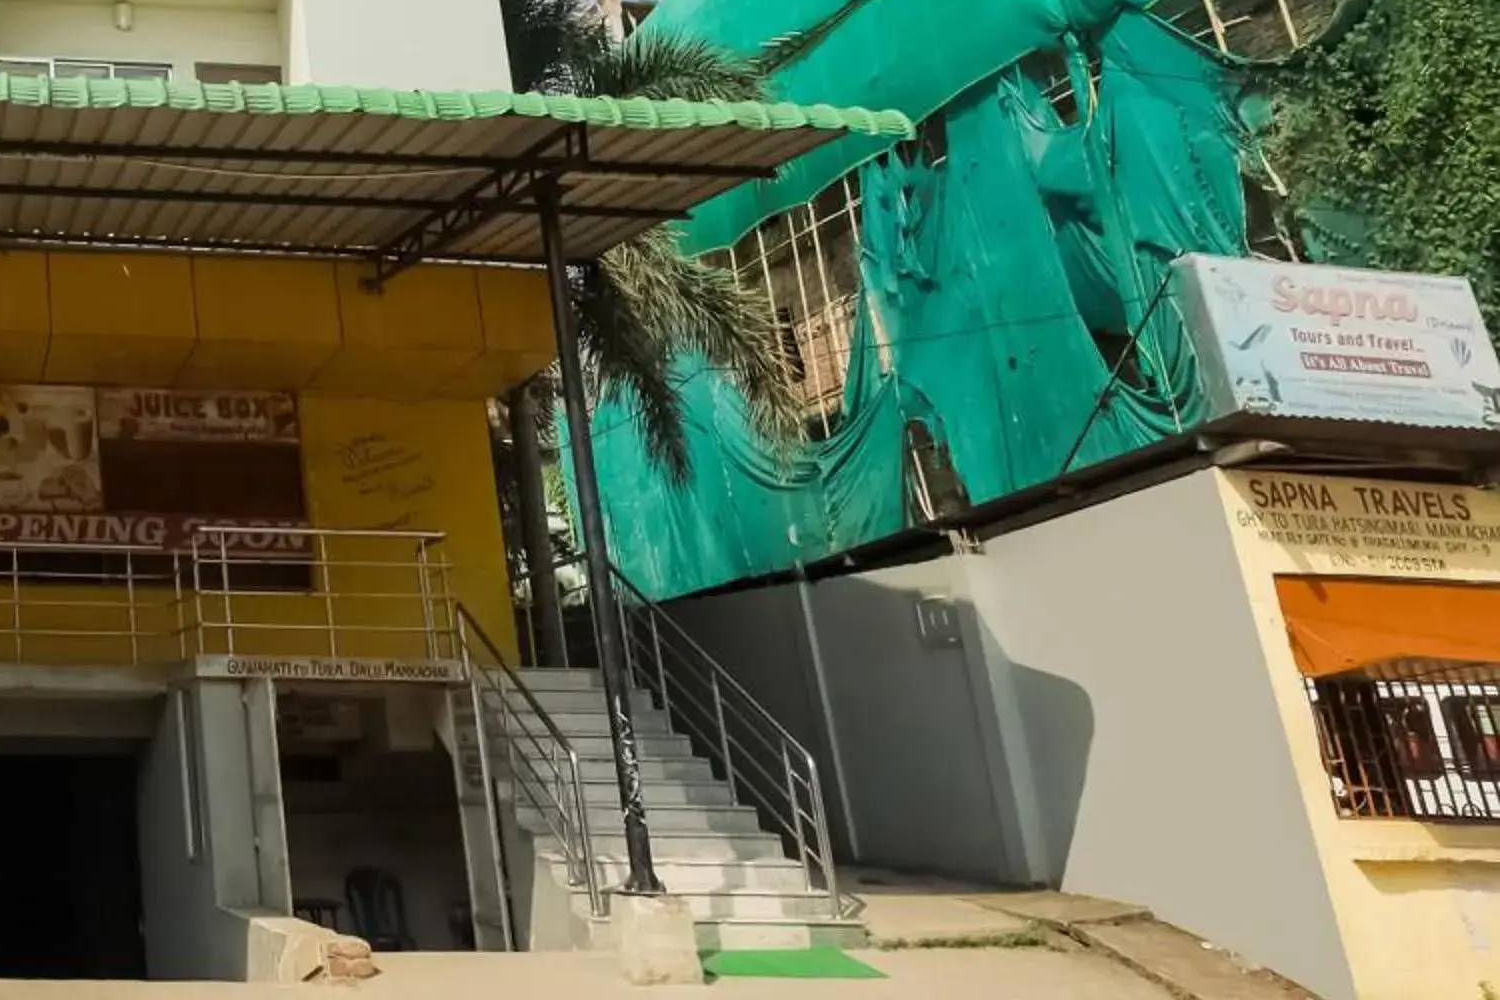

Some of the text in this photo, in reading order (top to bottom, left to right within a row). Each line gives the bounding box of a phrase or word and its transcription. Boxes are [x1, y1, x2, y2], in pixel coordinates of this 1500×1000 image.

[1271, 276, 1419, 327] Sapna
[1290, 327, 1332, 346] Tours
[1337, 331, 1364, 347] and
[130, 391, 272, 420] JUICE BOX
[1250, 479, 1472, 522] SAPNA TRAVELS
[182, 517, 311, 551] SOON
